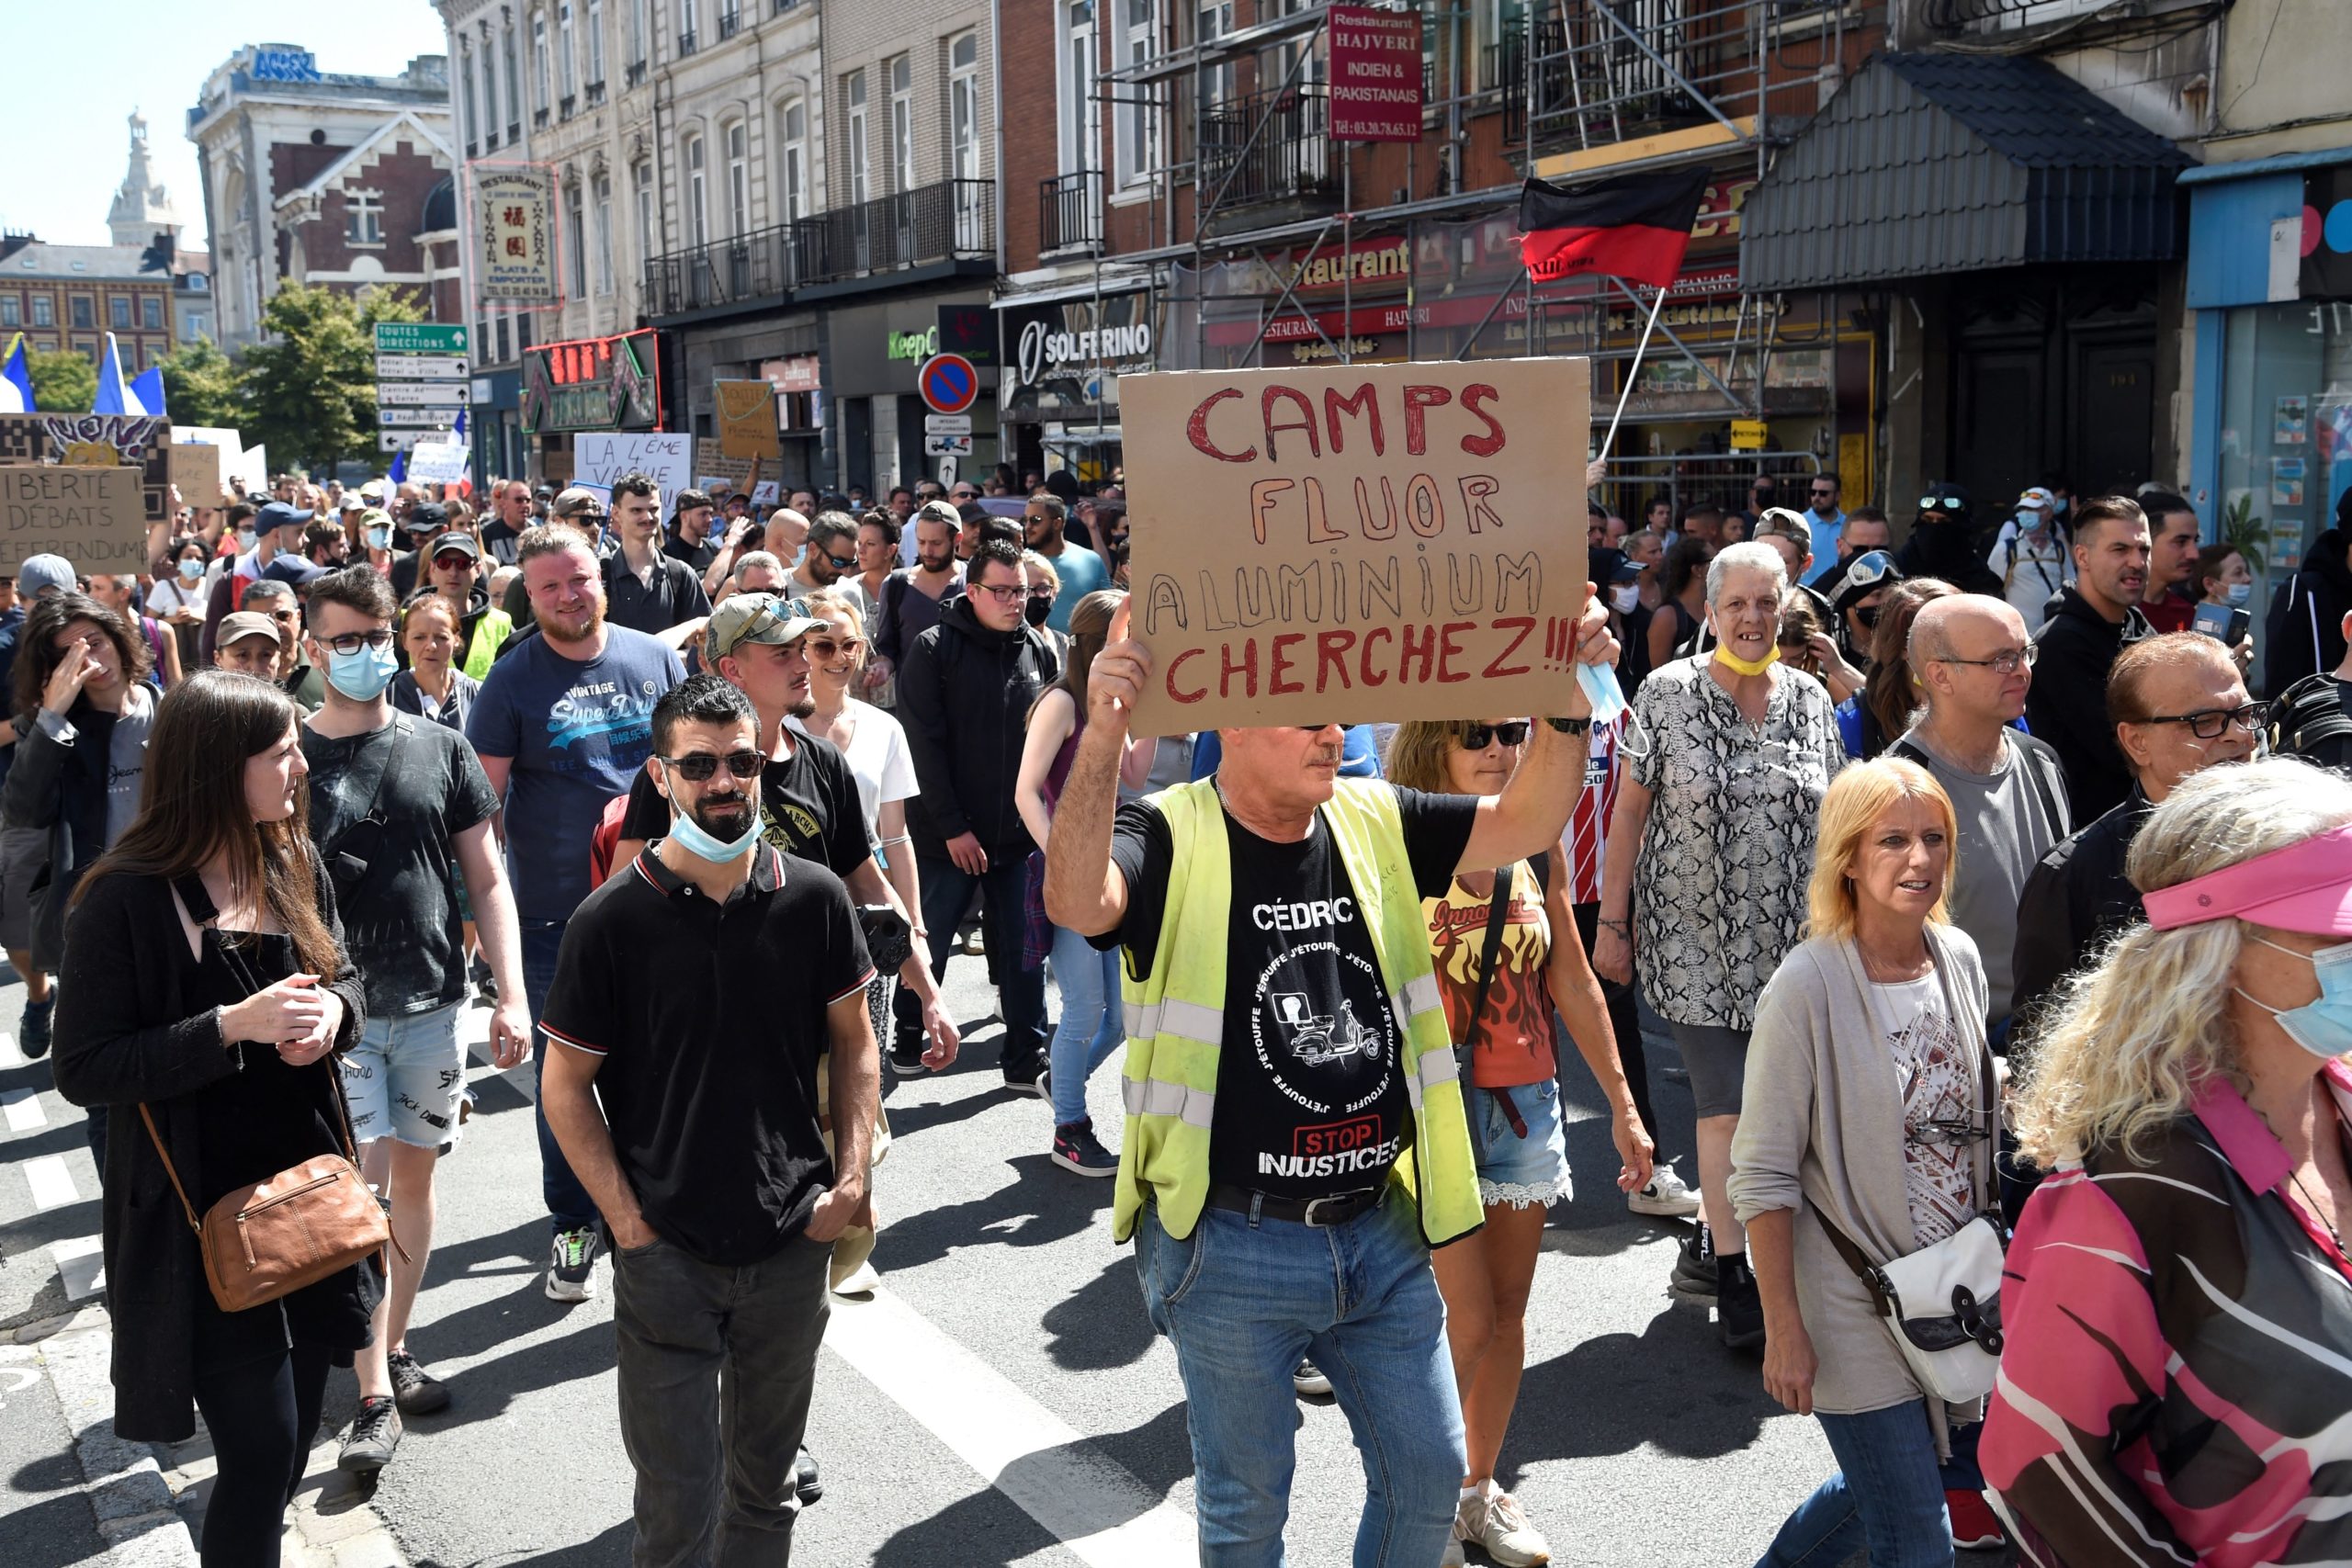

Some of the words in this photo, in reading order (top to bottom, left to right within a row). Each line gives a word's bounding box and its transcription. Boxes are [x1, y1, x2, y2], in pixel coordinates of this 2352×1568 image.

[1334, 14, 1413, 28] Restaurant
[1336, 33, 1416, 51] HAJVERI
[1348, 62, 1391, 77] INDIEN
[1394, 64, 1404, 77] &
[1333, 86, 1419, 103] PAKISTANAIS
[480, 175, 544, 191] RESTAURANT
[493, 265, 528, 274] PLATS
[379, 326, 419, 336] TOUTES
[379, 338, 445, 348] DIRECTIONS
[1186, 382, 1507, 463] CAMPS
[585, 439, 615, 465] LA
[8, 503, 114, 531] DÉBATS
[1250, 473, 1504, 545] FLUOR
[570, 682, 616, 698] VINTAGE
[1429, 892, 1532, 932] Innont
[1290, 942, 1340, 958] J'ÉTOUFE
[1255, 953, 1288, 1002] J'ÉTOUFFE
[1251, 1007, 1273, 1071] J'ÉTOUFFE
[1381, 1004, 1394, 1069] J'ÉTOUFFE
[1272, 1074, 1330, 1114] J'ÉTOUFFE
[1345, 1072, 1390, 1113] J'ÉTOUFFE
[1305, 1123, 1373, 1155] STOP
[1258, 1135, 1400, 1178] INJUSTICES
